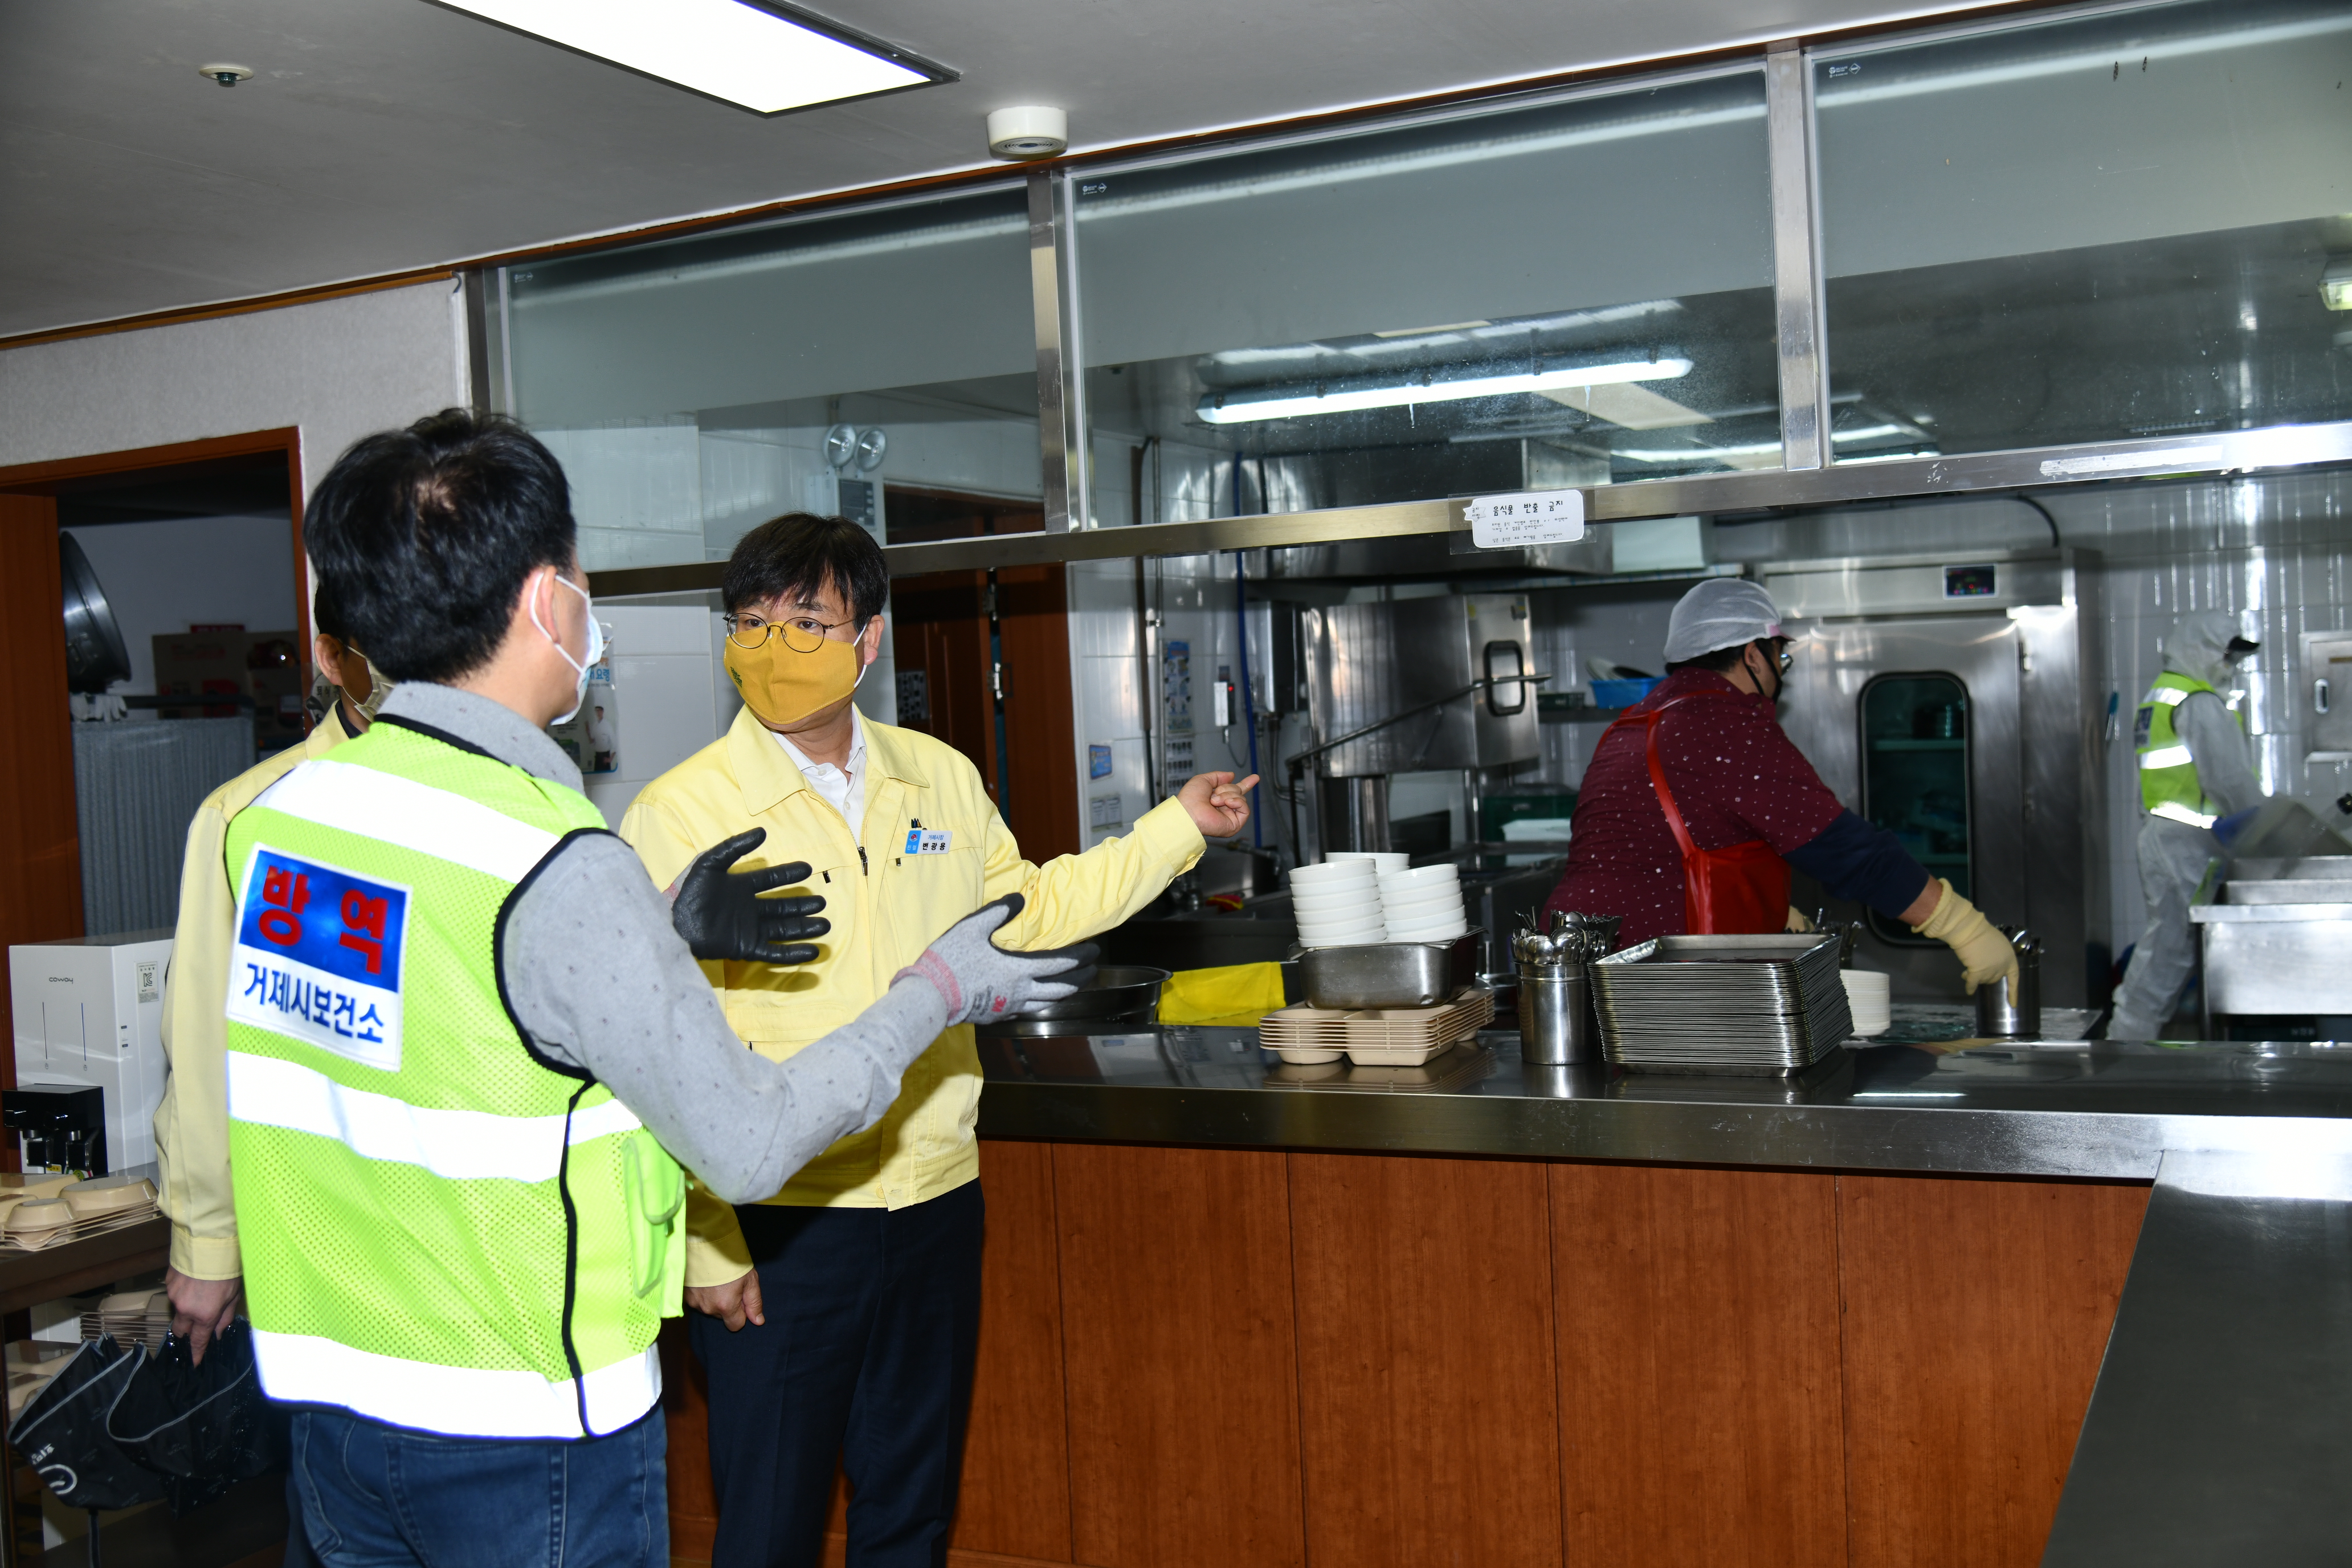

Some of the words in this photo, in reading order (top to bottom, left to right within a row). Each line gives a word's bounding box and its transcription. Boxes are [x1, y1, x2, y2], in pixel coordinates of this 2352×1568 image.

[1493, 505, 1513, 516] 음식물
[1523, 503, 1538, 514] 반출
[1548, 500, 1563, 512] 금지
[922, 842, 946, 851] 변광용
[258, 864, 389, 976] 방역
[244, 962, 385, 1045] 거제시보건소
[991, 995, 1007, 1012] 3M
